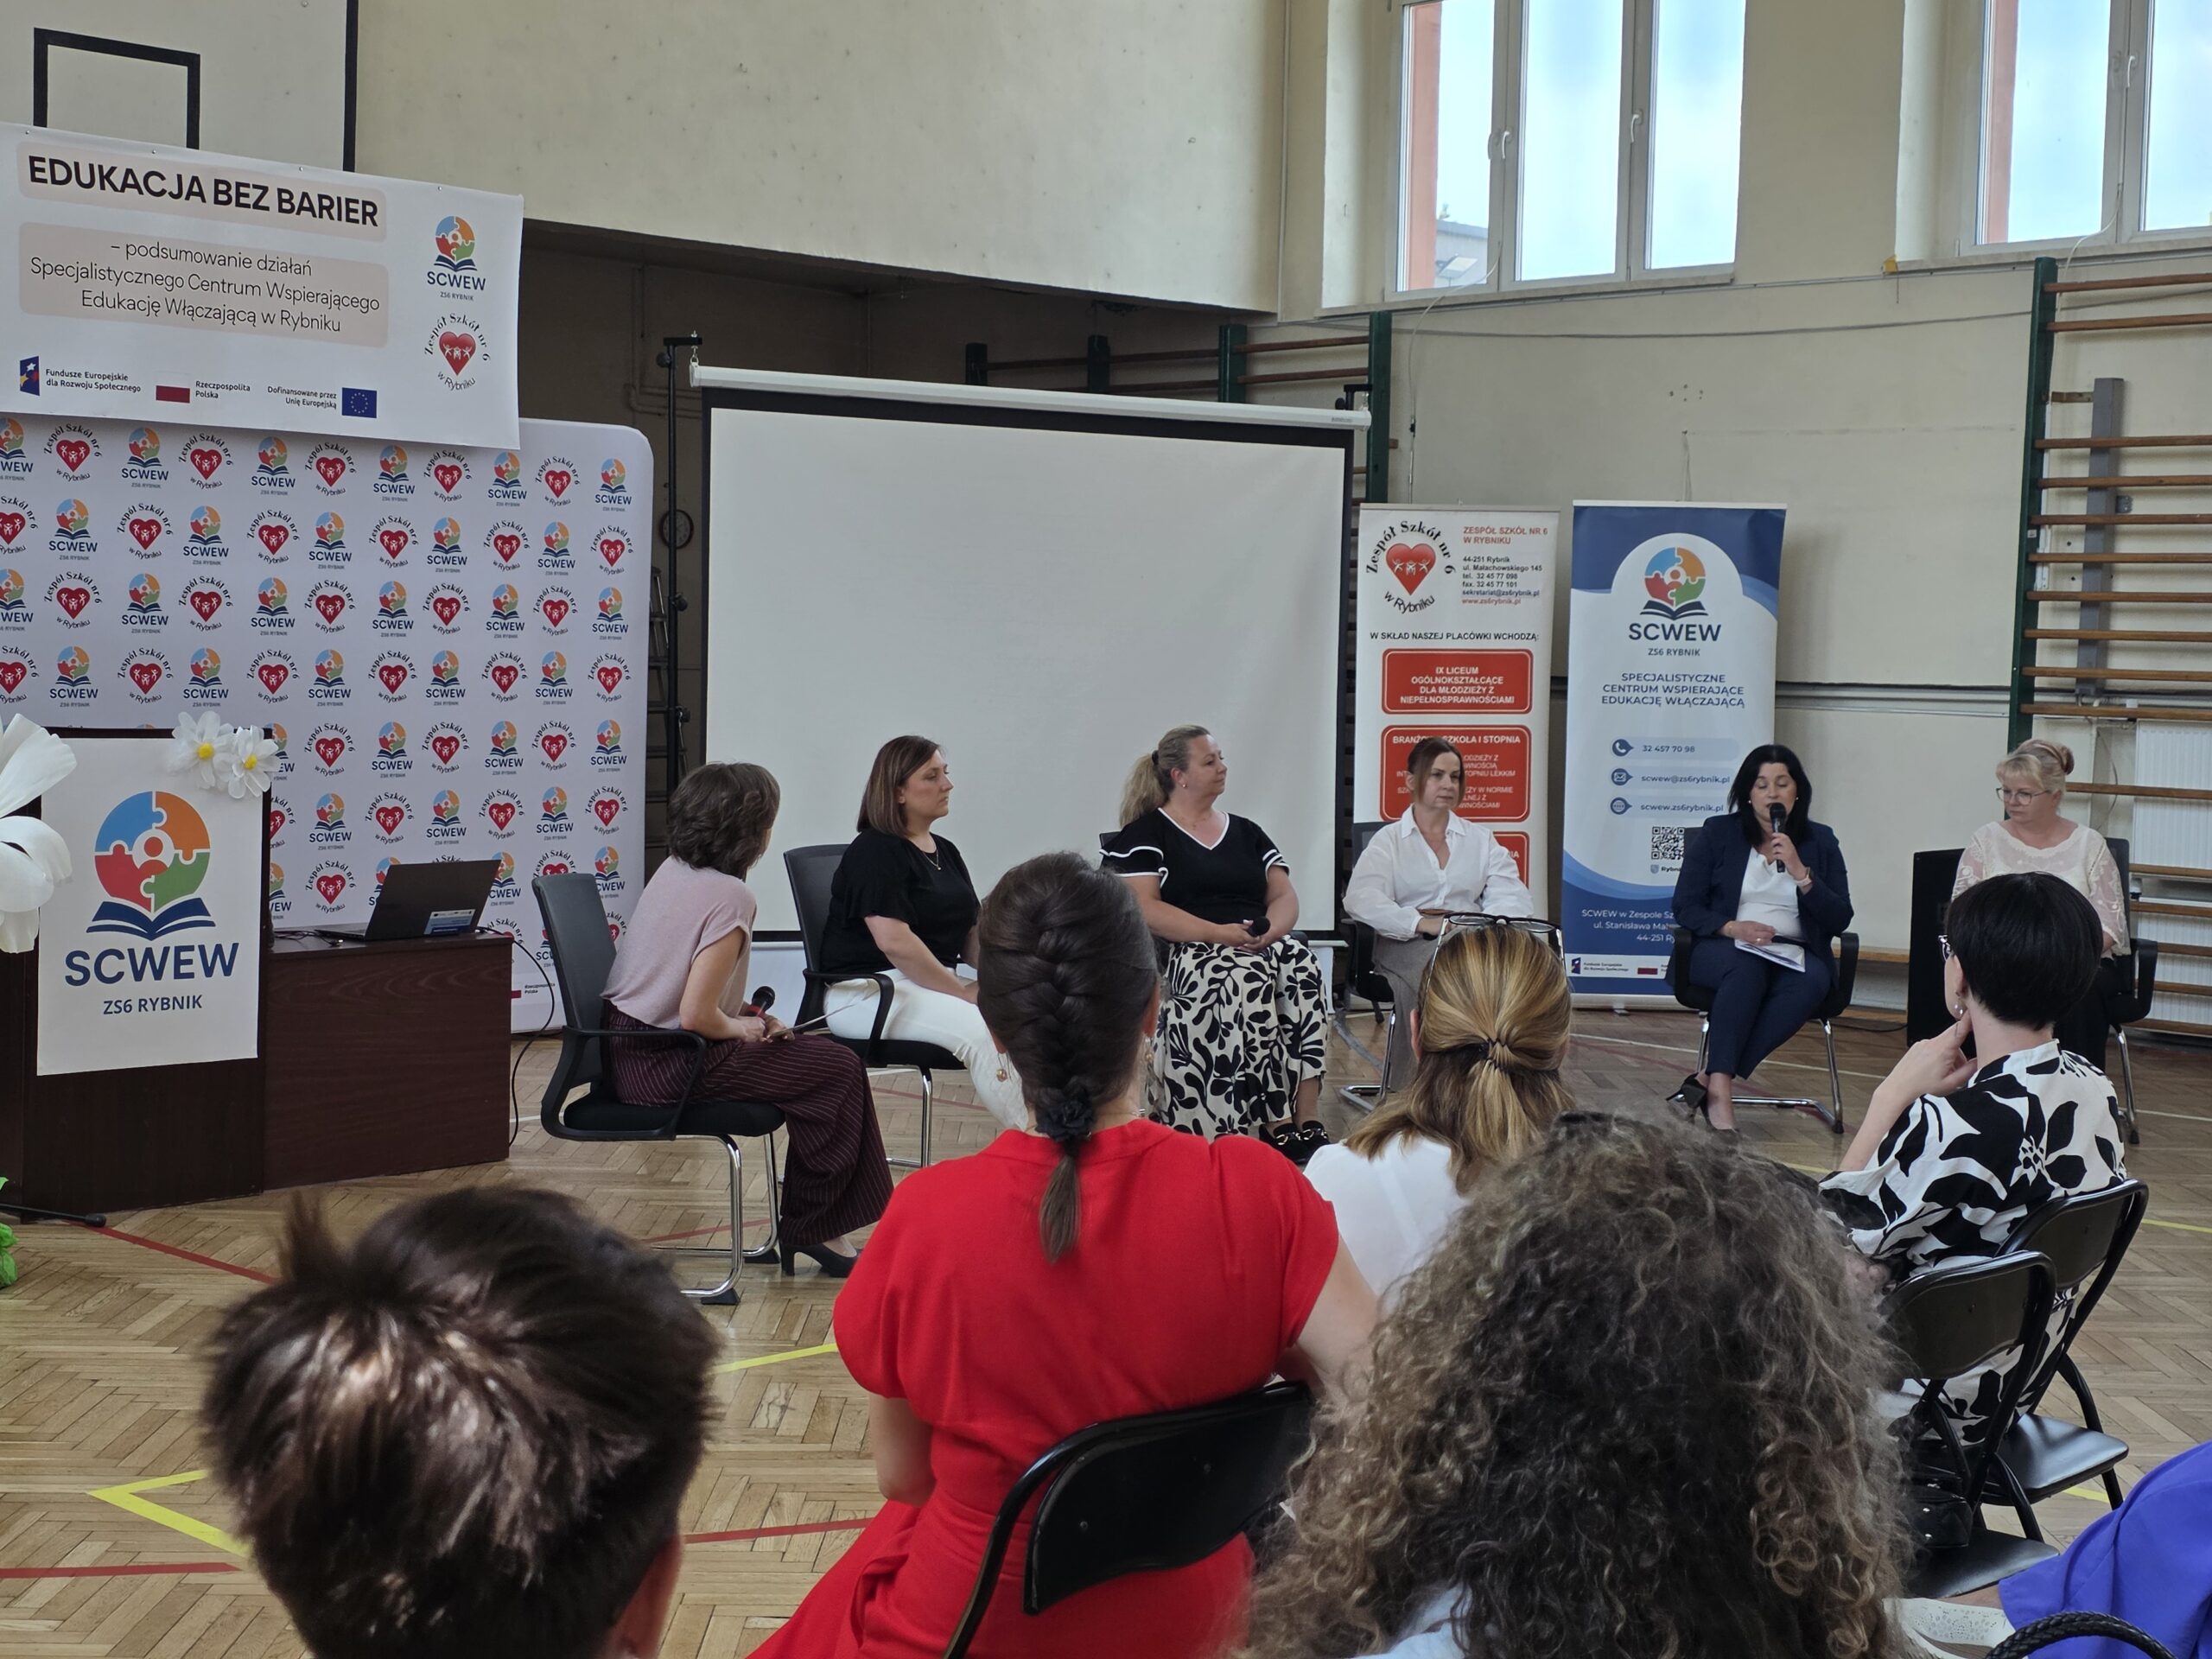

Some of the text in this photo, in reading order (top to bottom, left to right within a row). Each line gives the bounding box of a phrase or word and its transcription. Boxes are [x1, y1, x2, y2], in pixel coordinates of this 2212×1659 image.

[29, 155, 378, 227] EDUKACJA BEZ BARIER
[125, 241, 252, 269] podsumowanie
[257, 254, 312, 276] działań
[30, 257, 380, 314] Specjalistycznego Centrum Wspierającego
[427, 271, 486, 290] SCWEW
[452, 292, 474, 301] RYBNIK
[82, 289, 340, 332] Edukację Włączającą w Rybniku
[478, 334, 487, 347] nr
[482, 353, 491, 363] 6
[46, 369, 129, 382] Fundusze Europejskie
[437, 371, 476, 391] w Rybniku
[46, 378, 142, 393] dla Rozwoju Społecznego
[195, 380, 251, 392] Rzeczpospolita
[195, 390, 219, 399] Polska
[267, 386, 337, 400] Dofinansowane przez
[285, 397, 337, 410] Unię Europejską
[0, 461, 34, 473] WEW
[62, 472, 90, 482] Rybniku
[122, 468, 168, 480] SCWEW
[251, 476, 296, 487] SCWEW
[373, 483, 415, 494] SCWEW
[488, 489, 527, 499] SCWEW
[595, 494, 632, 505] SCWEW
[1463, 525, 1497, 535] ZESPÓŁ
[1499, 525, 1527, 535] SZKÓŁ
[1542, 527, 1548, 536] 6
[49, 541, 98, 553] SCWEW
[183, 546, 229, 557] SCWEW
[1366, 520, 1457, 575] Zespół Szkół nr 6
[308, 550, 352, 562] SCWEW
[427, 555, 467, 565] SCWEW
[1486, 556, 1510, 564] Rybnik
[537, 558, 575, 569] SCWEW
[1384, 591, 1435, 614] w Rybniku
[0, 613, 34, 623] WEW
[122, 614, 168, 626] SCWEW
[251, 617, 295, 628] SCWEW
[372, 620, 414, 630] SCWEW
[486, 621, 524, 632] SCWEW
[592, 623, 628, 633] SCWEW
[1446, 631, 1491, 640] PLACÓWKI
[1628, 623, 1722, 641] SCWEW
[1666, 648, 1700, 657] RYBNIK
[1411, 676, 1503, 685] OGÓLNOKSZTAŁCĄCE
[1621, 672, 1726, 683] SPECJALISTYCZNE
[49, 688, 99, 698] SCWEW
[183, 689, 229, 699] SCWEW
[308, 689, 351, 699] SCWEW
[426, 689, 466, 698] SCWEW
[536, 689, 573, 697] SCWEW
[1438, 685, 1487, 694] MŁODZIEŻY
[1603, 683, 1745, 697] CENTRUM WSPIERAJĄCE
[1400, 695, 1515, 704] NIEPEŁNOSPRAWNOŚCIAMI
[1601, 696, 1745, 709] EDUKACJĘ WŁĄCZAJĄCĄ
[372, 760, 413, 771] SCWEW
[485, 758, 524, 768] SCWEW
[590, 755, 627, 766] SCWEW
[1641, 775, 1731, 784] scwew@zs6rybnik.pl
[1640, 804, 1724, 812] scwew.zs6rybnik.pl
[426, 827, 467, 838] SCWEW
[536, 823, 574, 834] SCWEW
[309, 831, 352, 842] SCWEW
[597, 881, 625, 892] CWEW
[489, 888, 521, 899] CWEW
[1581, 909, 1618, 918] SCWEW
[1629, 910, 1662, 919] Zespole
[65, 943, 239, 987] SCWEW
[103, 995, 202, 1015] ZS6 RYBNIK
